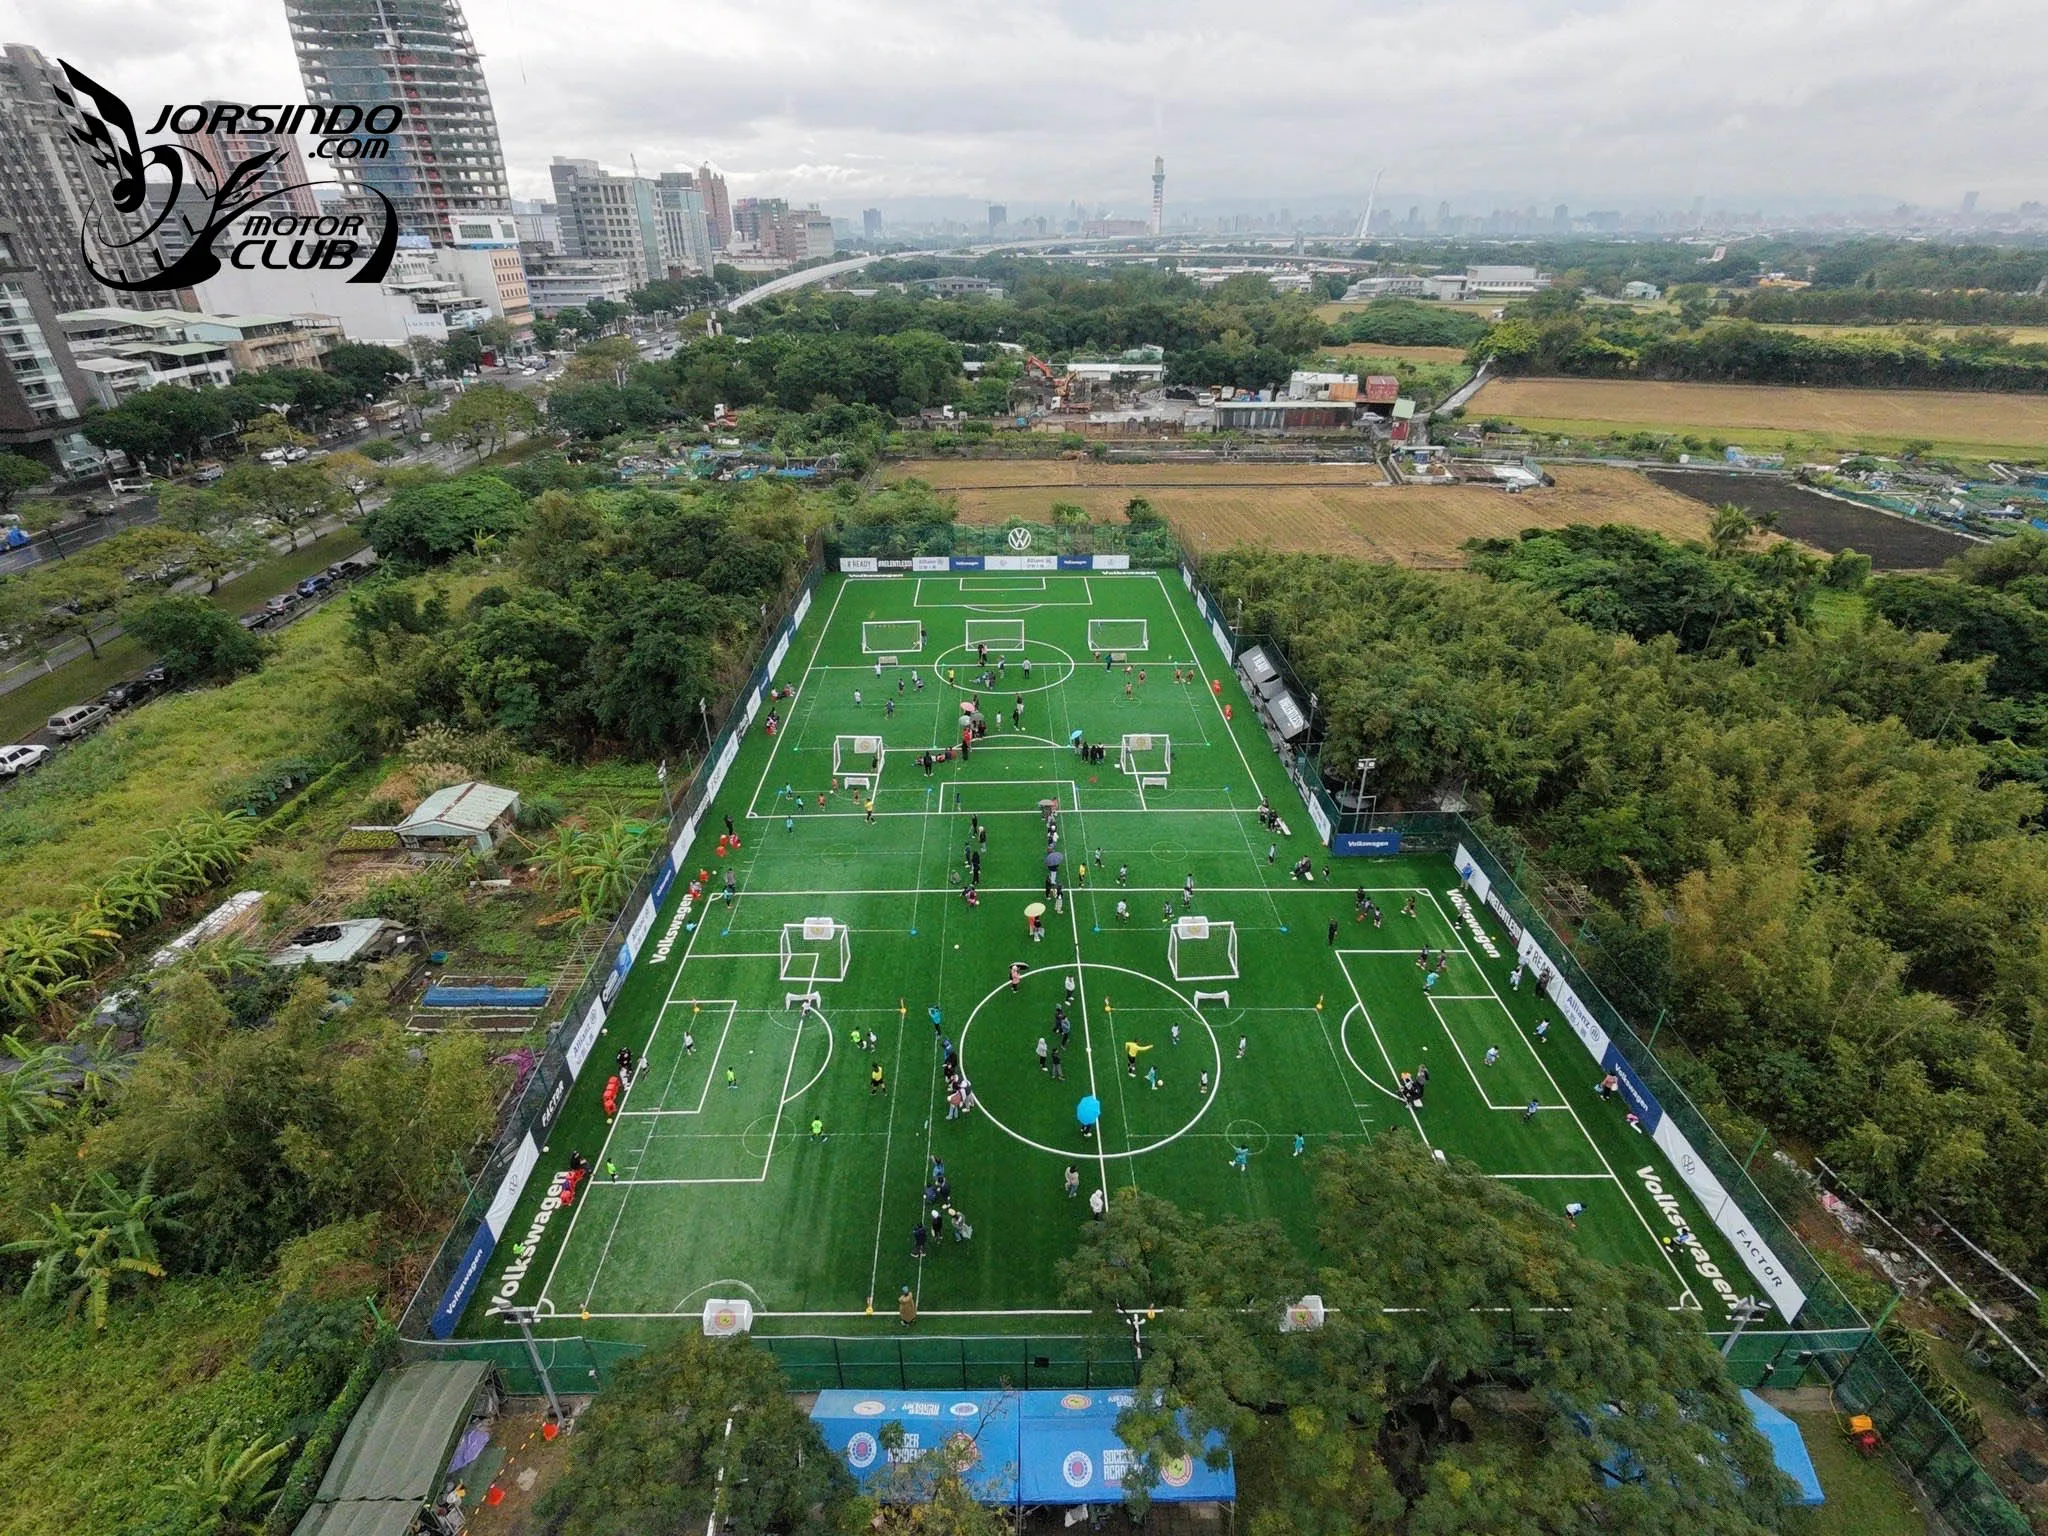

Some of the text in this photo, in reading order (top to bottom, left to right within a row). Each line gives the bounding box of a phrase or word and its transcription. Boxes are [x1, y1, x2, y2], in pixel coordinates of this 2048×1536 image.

[1347, 840, 1389, 848] Volkswagen
[649, 894, 694, 964] Volkswagen
[1567, 995, 1591, 1029] Allianz
[541, 1080, 565, 1128] FACTOR
[1614, 1062, 1649, 1112] Volkswagen
[446, 1248, 483, 1315] Volkswagen
[1735, 1229, 1783, 1288] FACTOR
